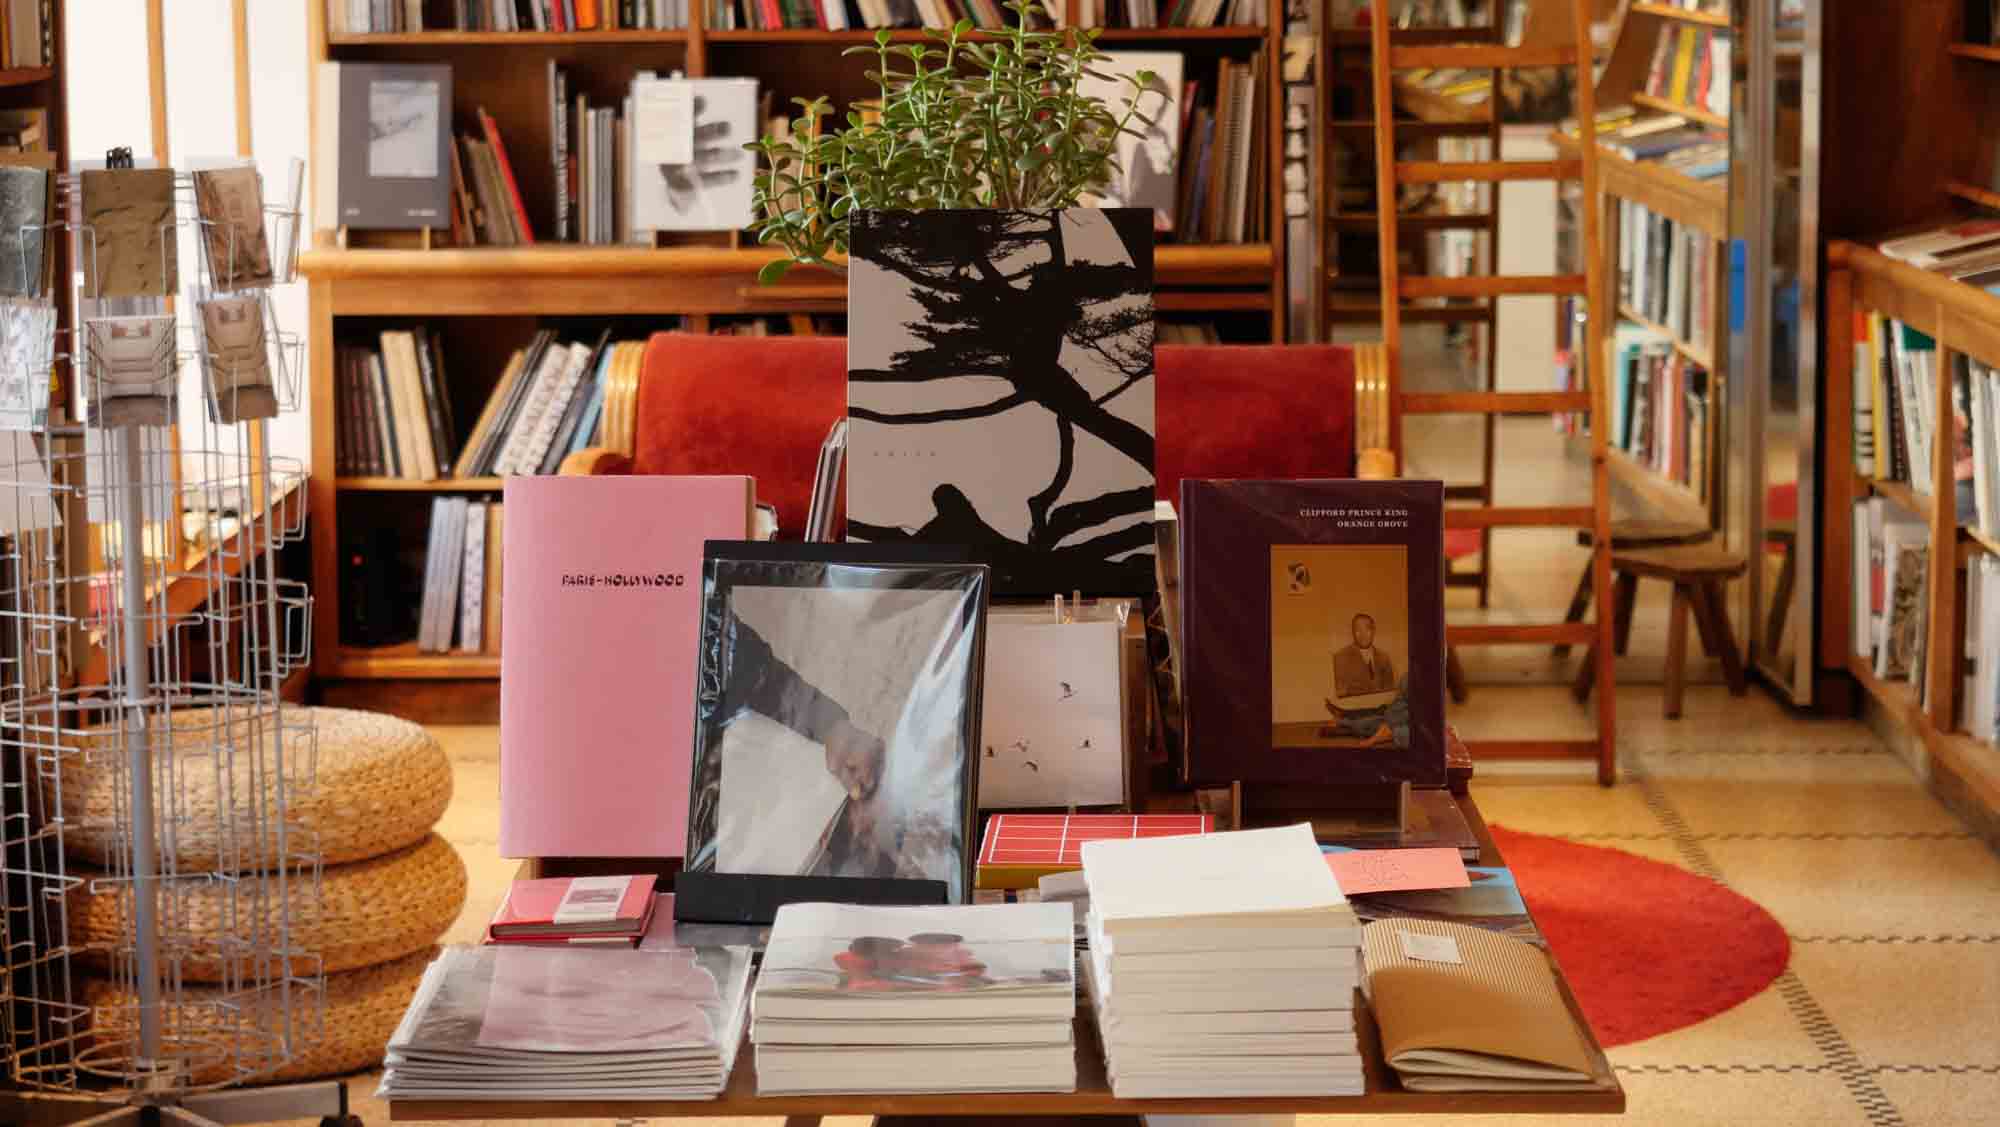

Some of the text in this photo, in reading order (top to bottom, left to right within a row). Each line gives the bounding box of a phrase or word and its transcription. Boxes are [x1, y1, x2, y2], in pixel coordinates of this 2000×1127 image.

[1299, 509, 1408, 517] CLIFFORD PRINCE KING
[1337, 520, 1408, 528] ORANGE GROVE
[562, 574, 684, 586] PARIS-HOLLYWOOD
